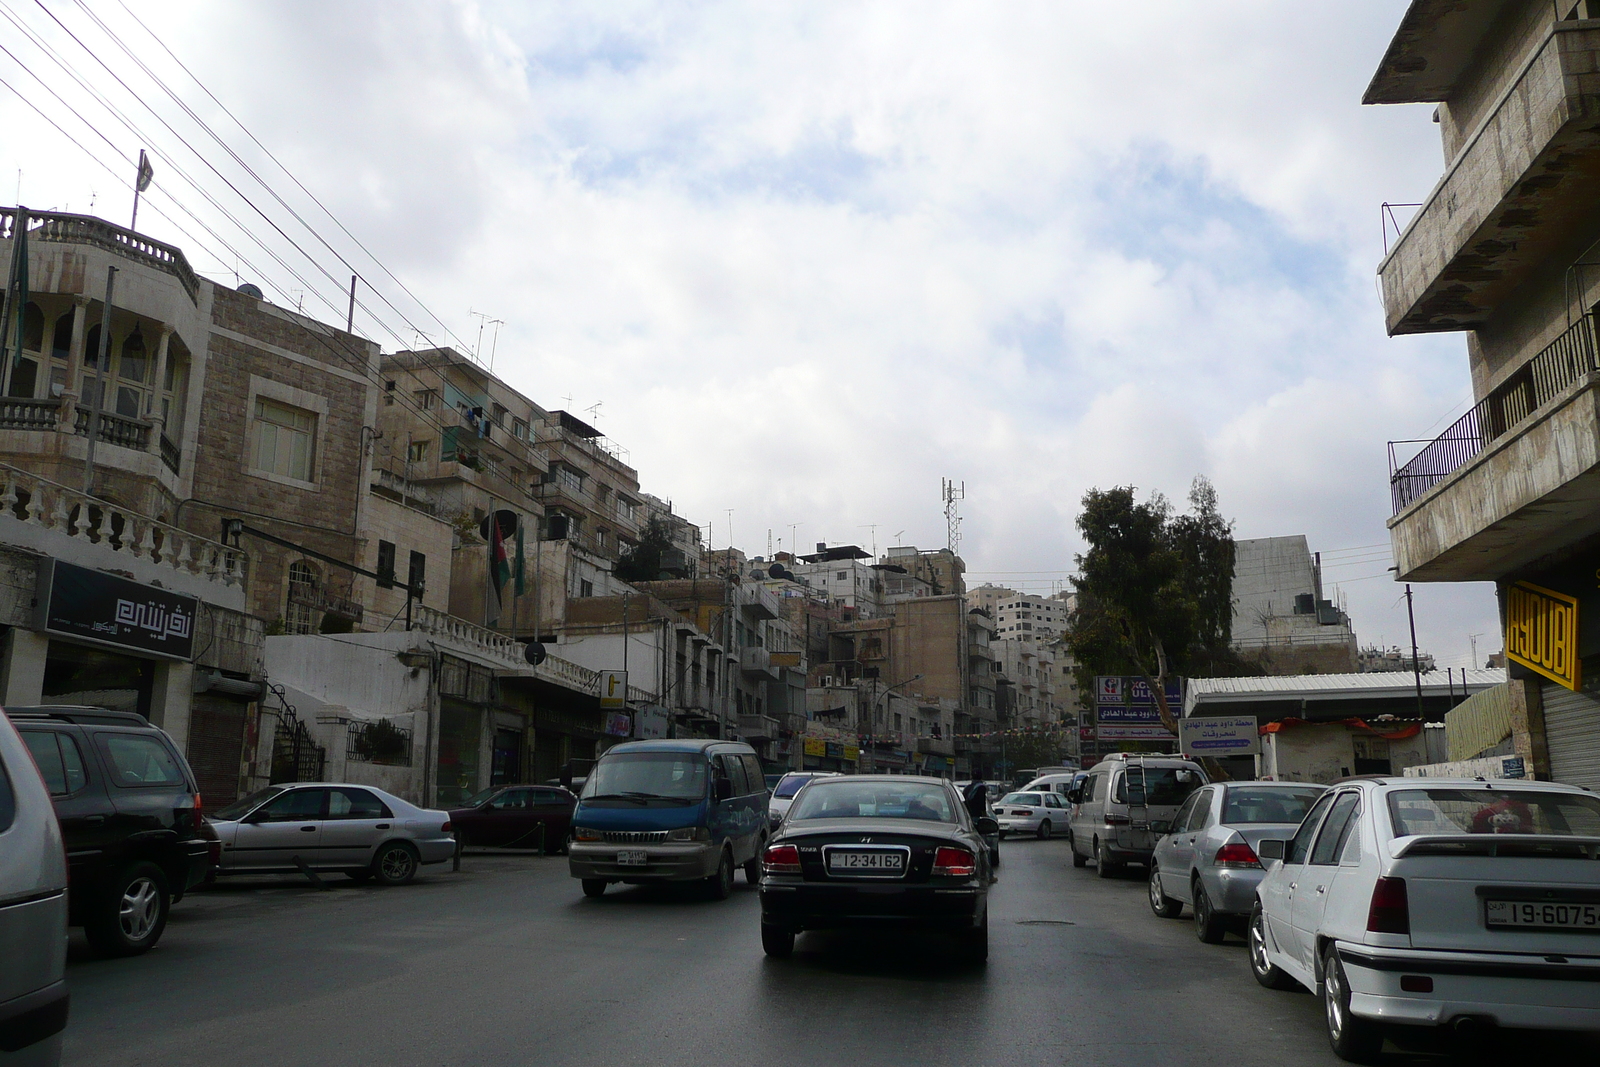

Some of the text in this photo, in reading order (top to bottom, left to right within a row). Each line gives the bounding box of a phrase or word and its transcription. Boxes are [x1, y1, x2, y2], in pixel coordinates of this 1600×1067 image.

[1510, 586, 1573, 679] AYOUBI
[1100, 709, 1123, 720] الهادي
[1183, 720, 1204, 731] الهادي
[1205, 721, 1218, 730] عبد
[1512, 903, 1600, 926] 19-6075
